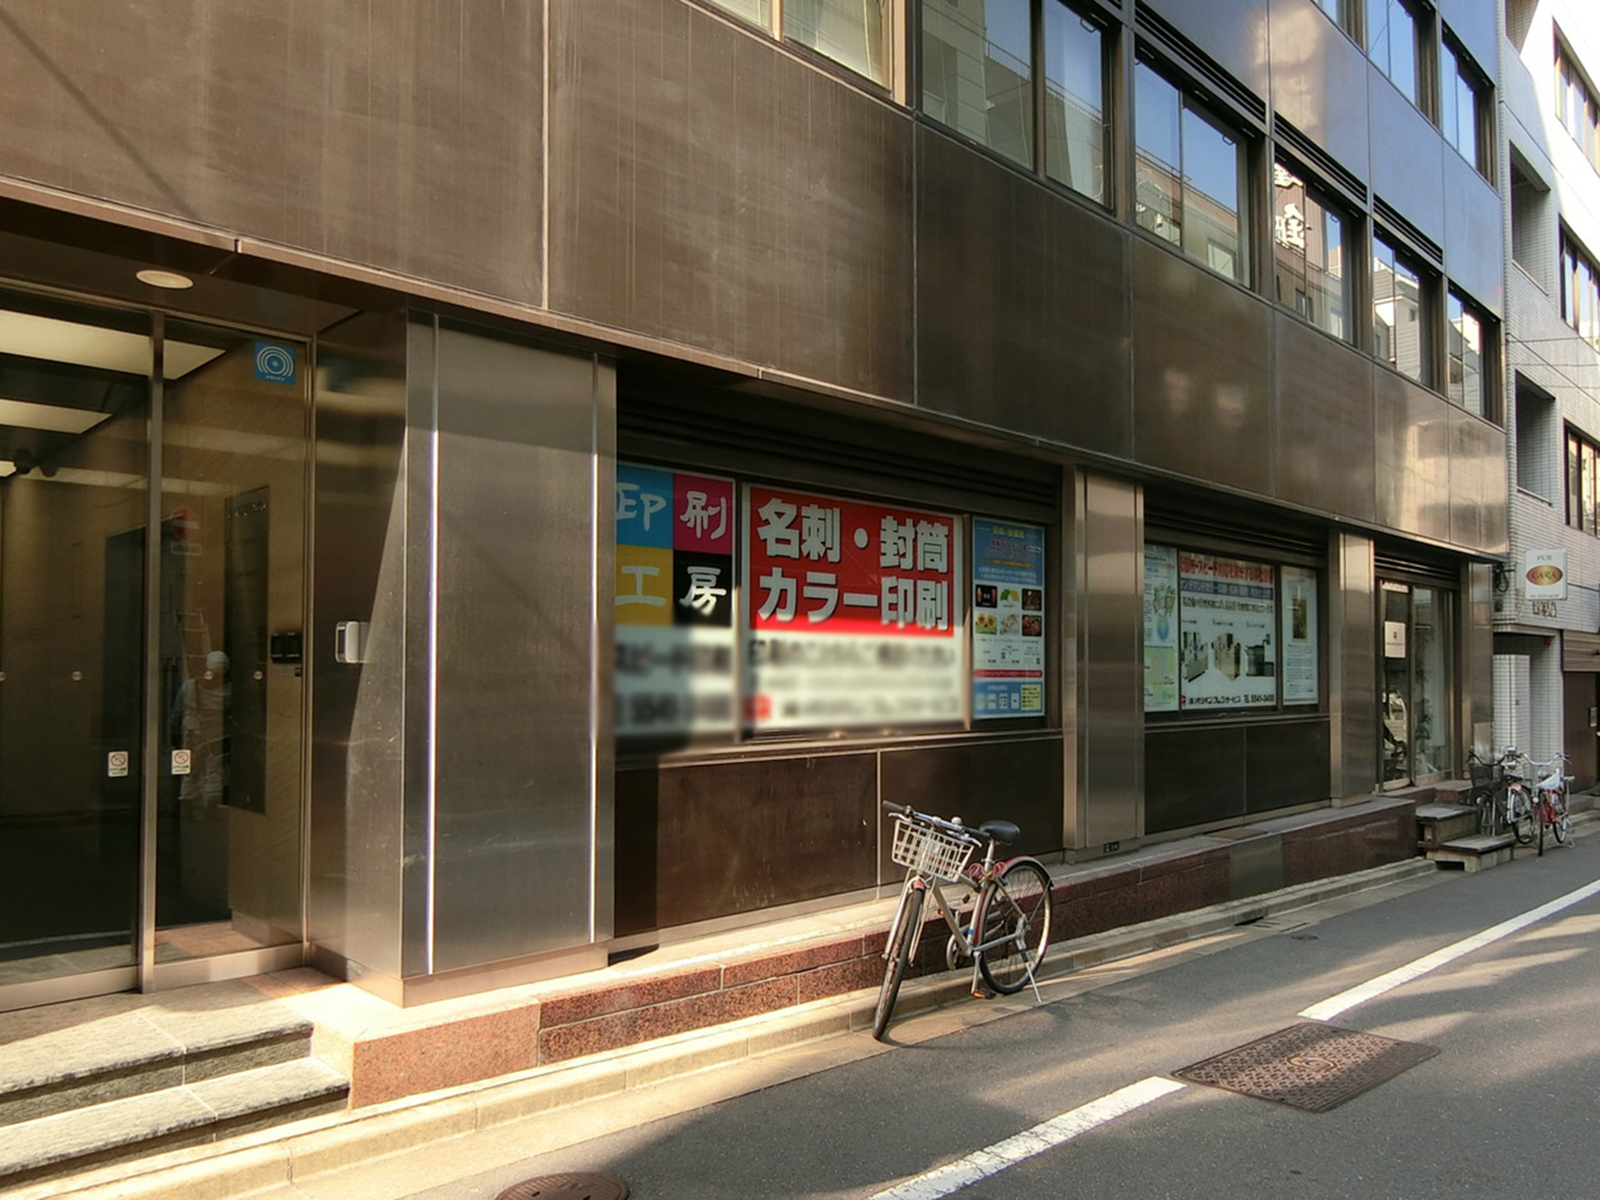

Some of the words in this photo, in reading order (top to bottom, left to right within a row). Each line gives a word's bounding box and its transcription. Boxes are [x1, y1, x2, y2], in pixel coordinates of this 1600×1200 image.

[616, 482, 728, 540] 印刷
[757, 497, 949, 574] 名刺・封筒
[615, 565, 728, 617] 工房
[757, 566, 949, 631] カラー印刷
